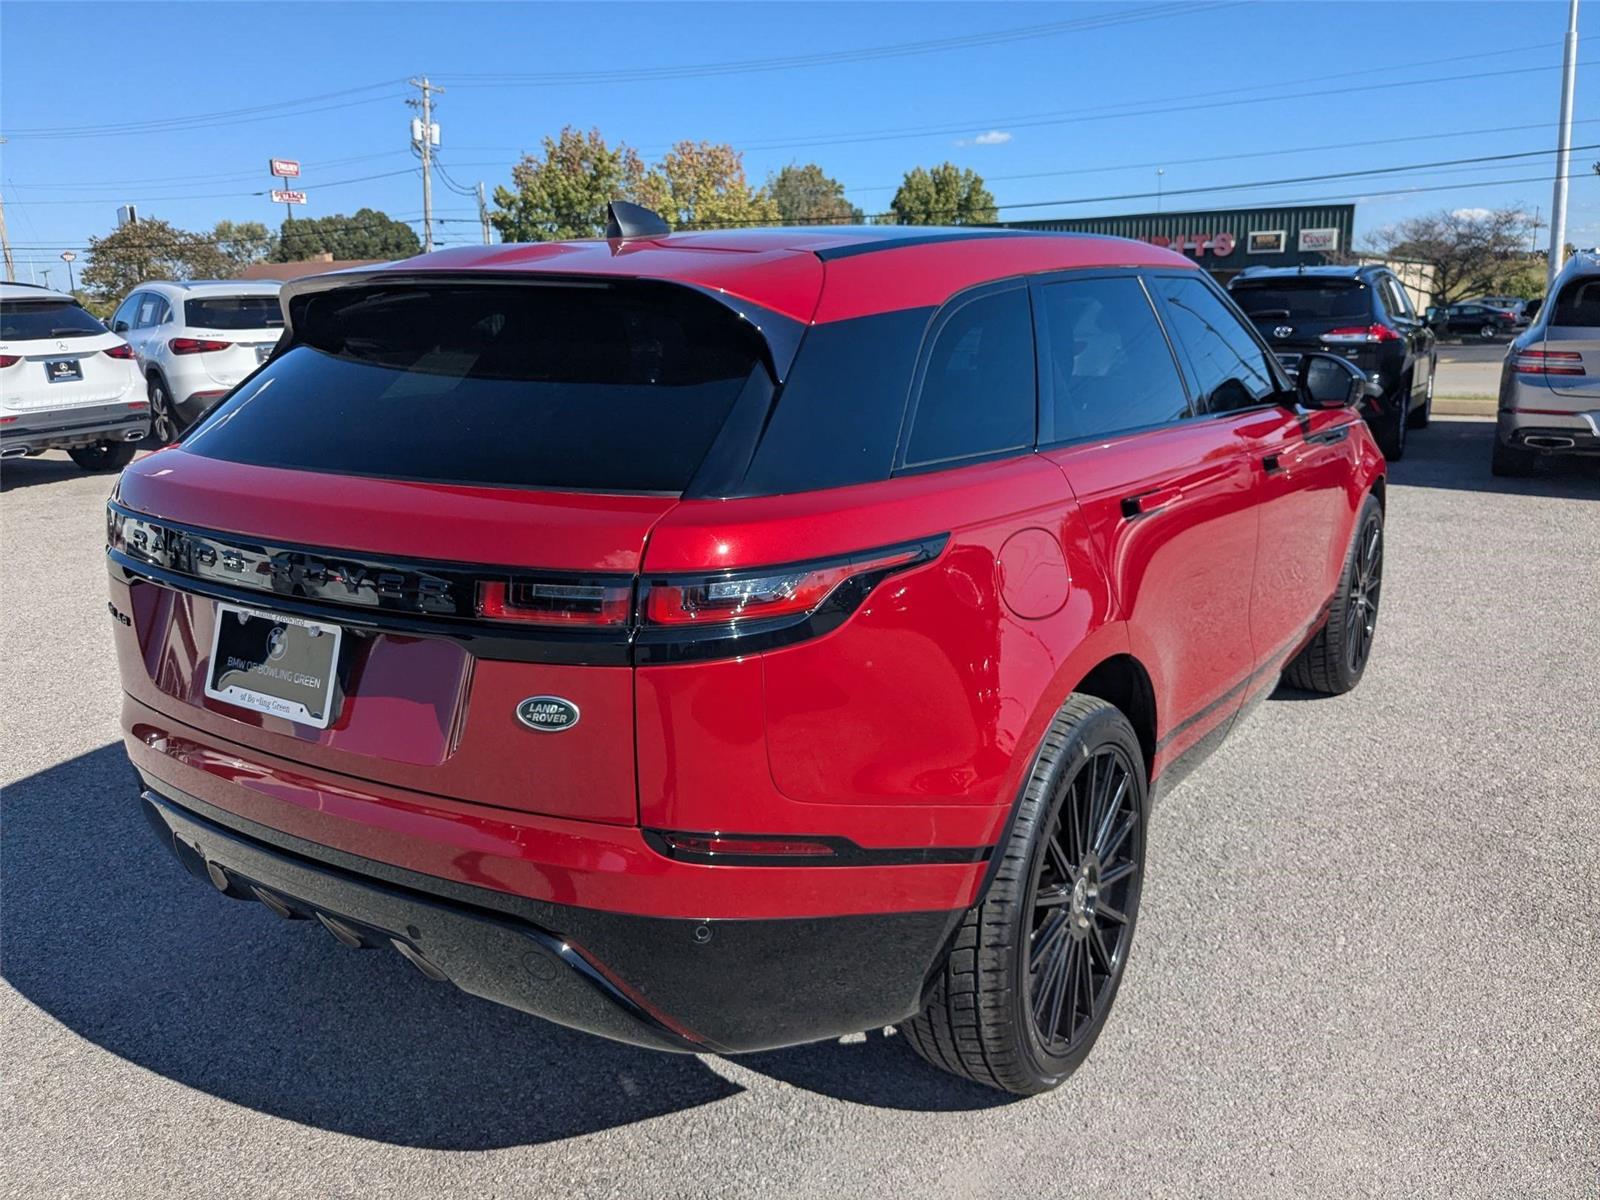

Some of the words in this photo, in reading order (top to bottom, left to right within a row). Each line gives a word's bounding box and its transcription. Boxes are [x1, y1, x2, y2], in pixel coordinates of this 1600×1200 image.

[133, 529, 246, 571] RANGE
[270, 556, 455, 612] ROVER
[227, 656, 245, 668] BMW
[246, 661, 257, 671] OF
[258, 664, 295, 682] BOWLING
[293, 672, 321, 689] GREEN
[272, 700, 290, 713] Green
[529, 703, 558, 713] LAND
[531, 712, 567, 723] ROVER
